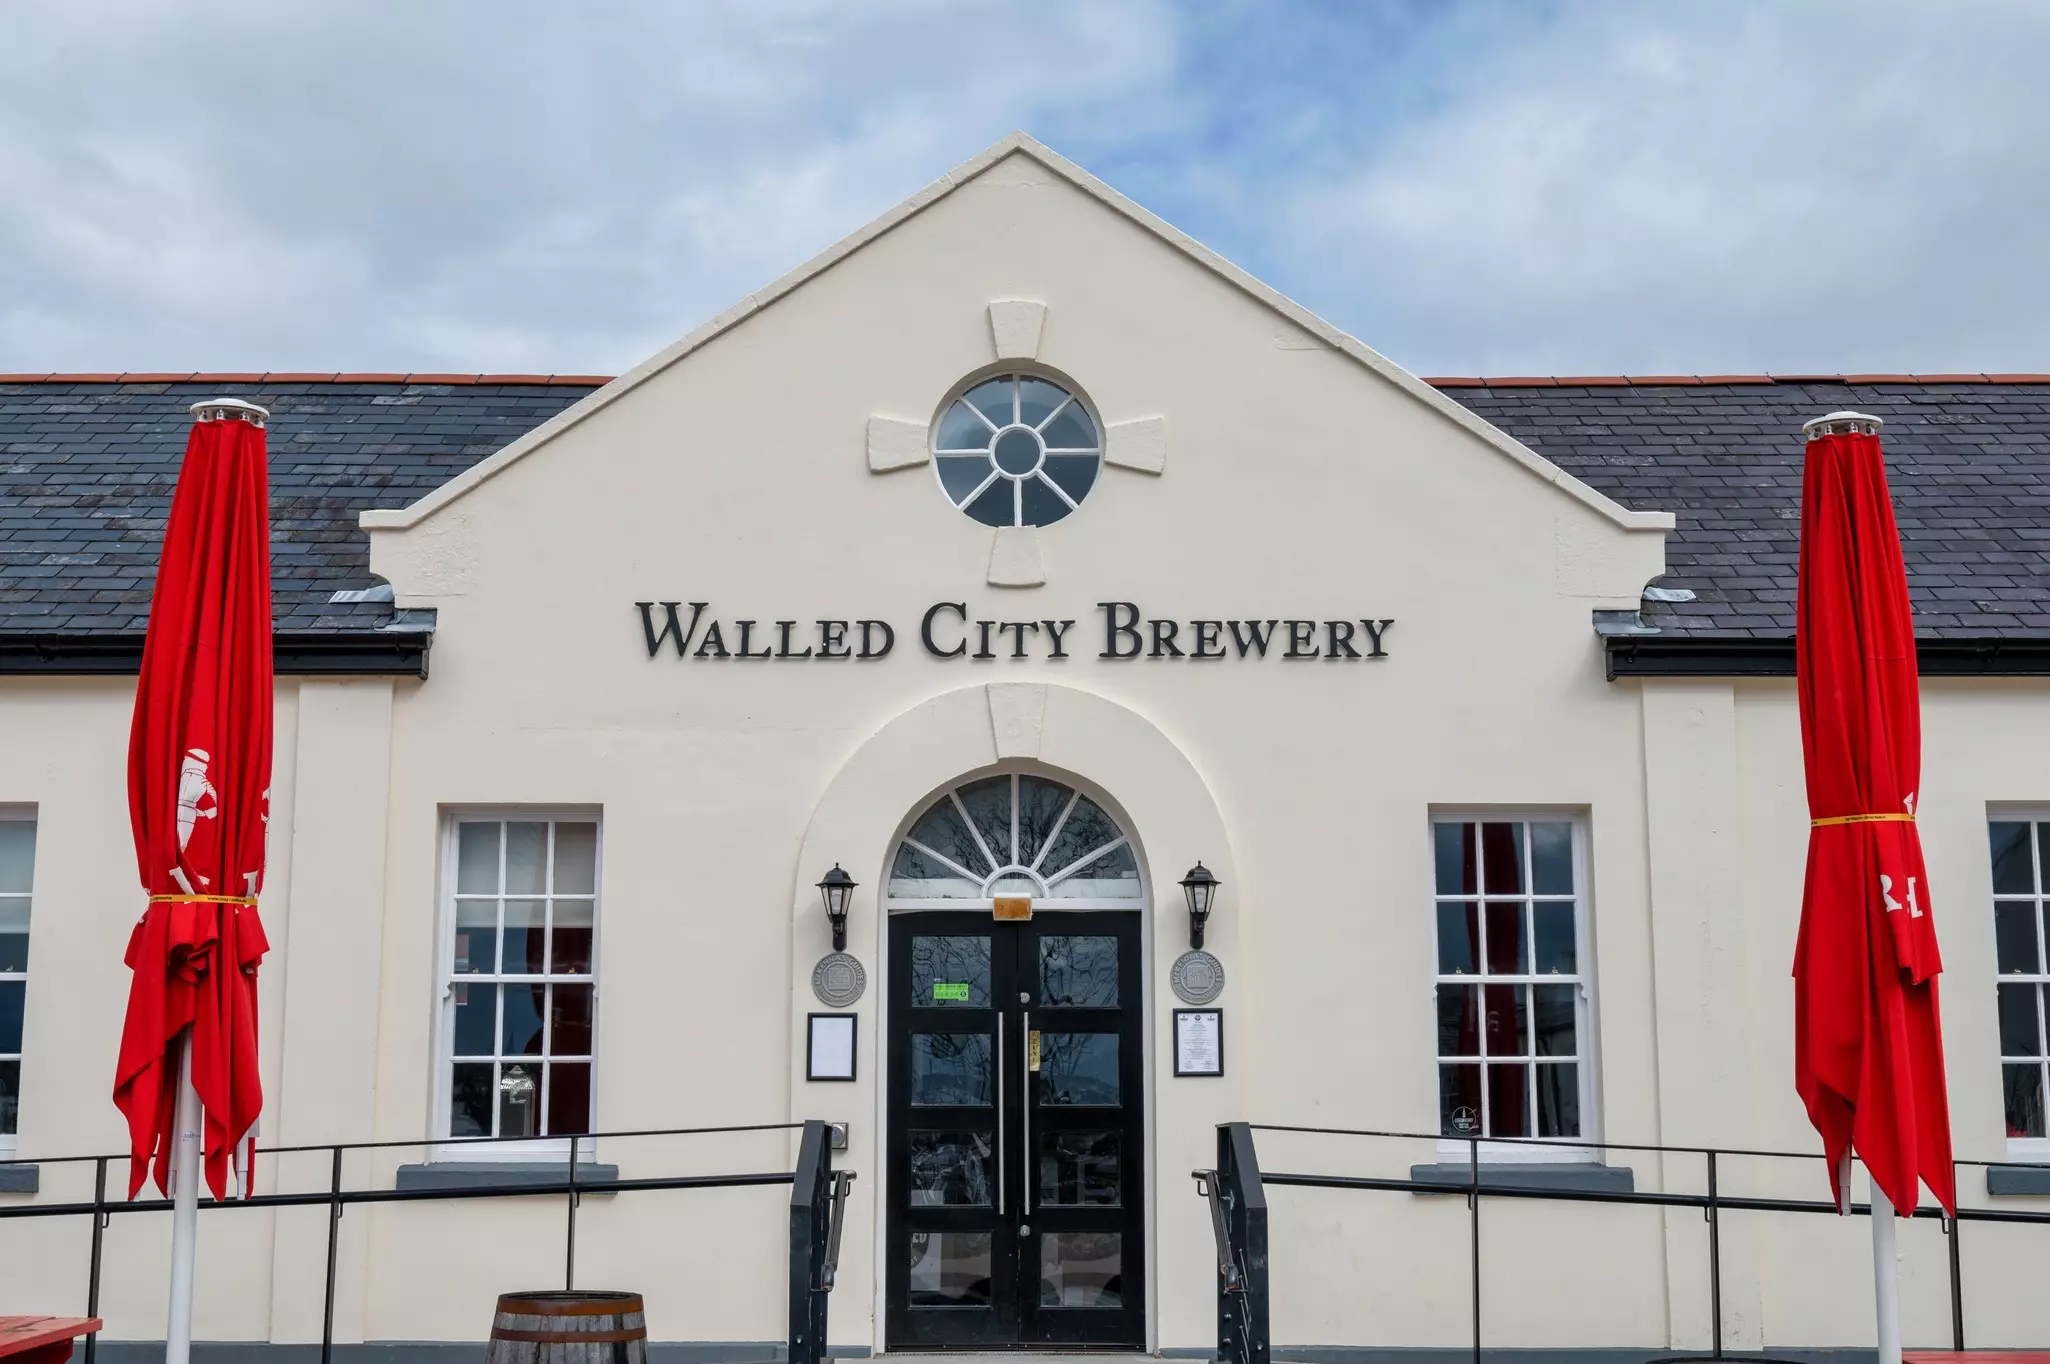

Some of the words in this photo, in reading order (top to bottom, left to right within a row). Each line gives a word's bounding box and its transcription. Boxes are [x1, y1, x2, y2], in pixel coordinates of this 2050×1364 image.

[634, 601, 895, 661] WALLED
[920, 601, 1076, 661] CITY
[1096, 601, 1395, 662] BREWERY
